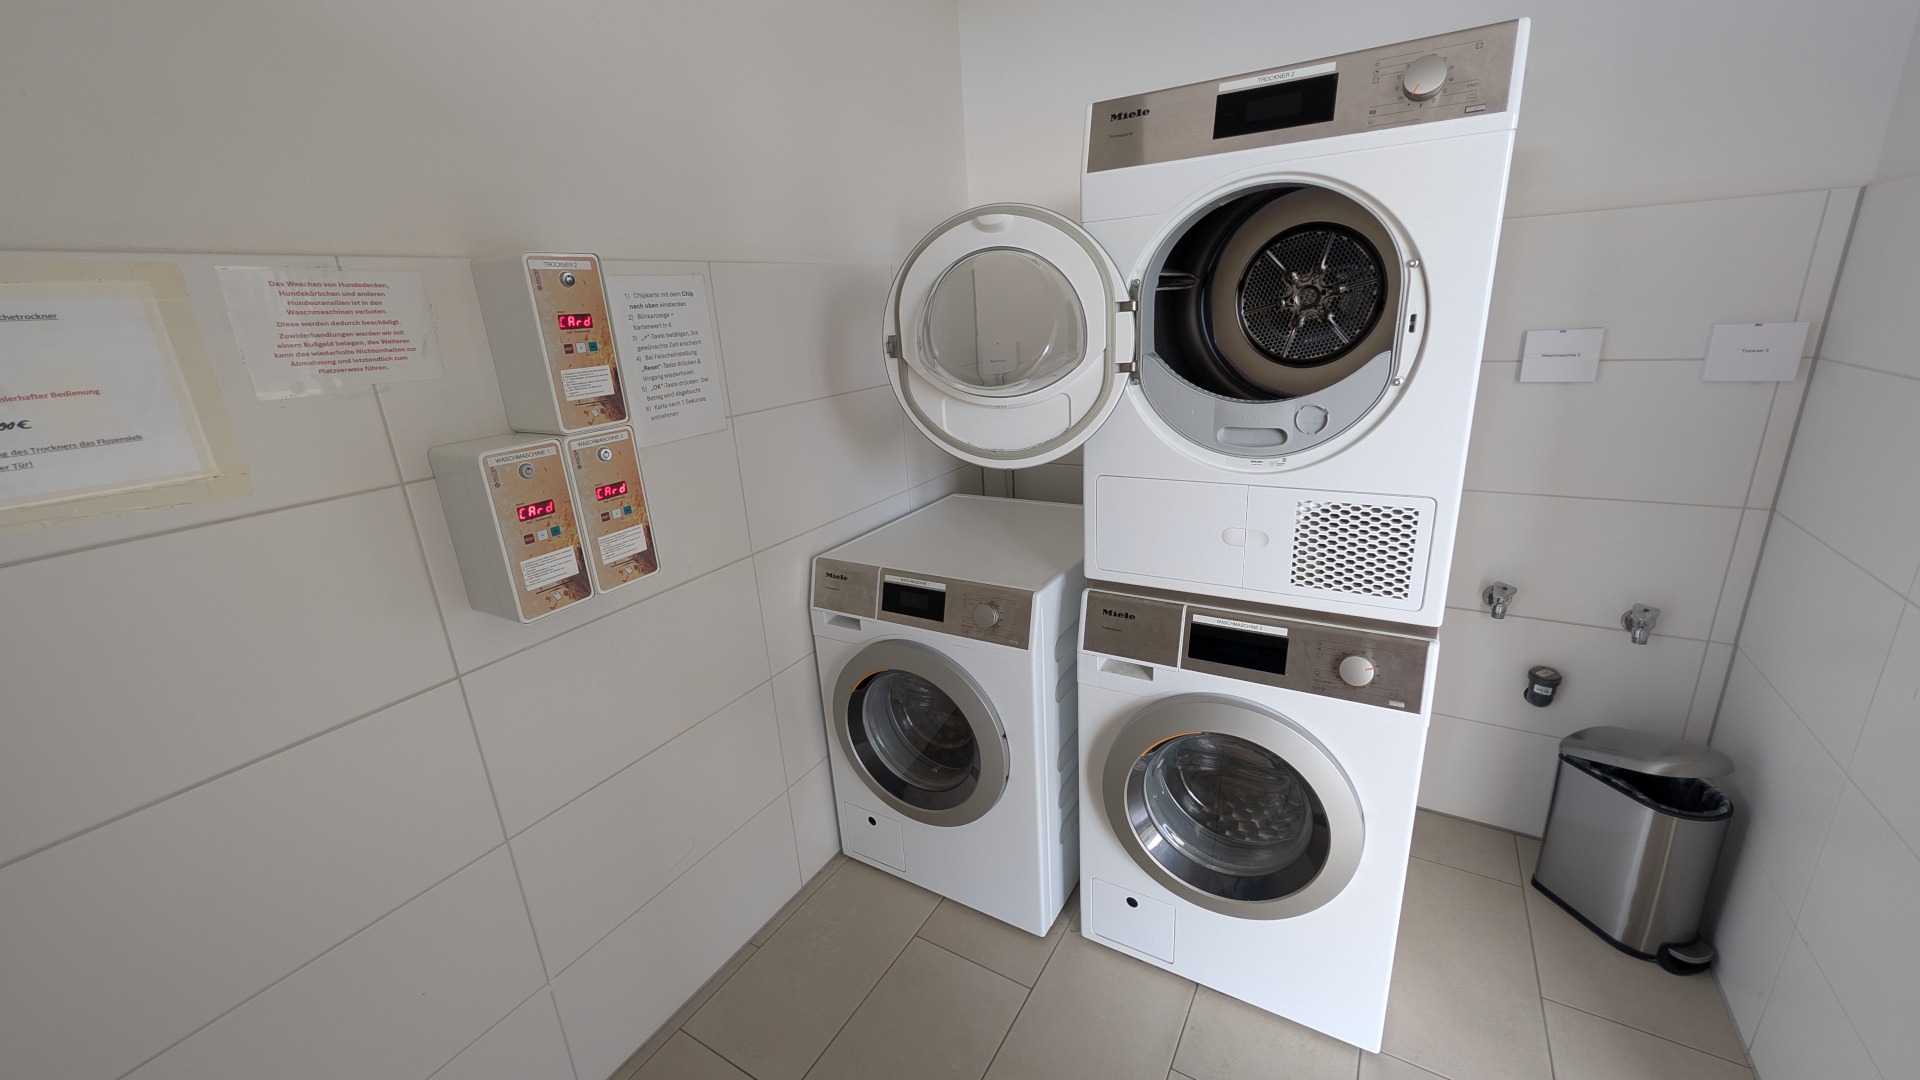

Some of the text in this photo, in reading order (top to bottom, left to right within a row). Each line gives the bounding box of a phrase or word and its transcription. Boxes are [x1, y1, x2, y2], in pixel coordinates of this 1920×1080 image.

[1257, 72, 1290, 83] TROCKNER
[1109, 107, 1151, 122] Miele
[543, 260, 574, 268] TROCKNER
[633, 291, 661, 300] Chipkarte
[629, 302, 645, 310] nach
[659, 300, 688, 308] einstecken
[0, 313, 58, 322] chetrockner
[637, 312, 671, 320] Blinkanzeige
[632, 323, 663, 331] Kartenwert
[278, 331, 355, 340] Zuwiderhandlungen
[310, 349, 356, 357] wiederholte
[356, 346, 406, 355] Nichteinhalten
[637, 343, 669, 353] gewünschte
[669, 341, 680, 349] Zeit
[644, 353, 654, 361] Bei
[653, 349, 698, 360] Falscheinstellung
[290, 359, 338, 367] Abmahnung
[677, 359, 697, 367] drücken
[318, 366, 364, 374] Platzverweis
[642, 369, 695, 382] Vorgang wiederholen
[50, 389, 101, 398] Bedienung
[646, 394, 665, 402] Betrag
[653, 403, 669, 411] Karte
[684, 396, 707, 405] Sekunde
[650, 411, 680, 421] entnehmen
[29, 443, 78, 454] Trockners
[96, 434, 143, 446] Flusensieb
[576, 434, 620, 448] WASCHMASCHINE
[494, 448, 547, 465] WASCHMASCHINE
[825, 571, 849, 581] Miele
[1102, 608, 1137, 621] Miele
